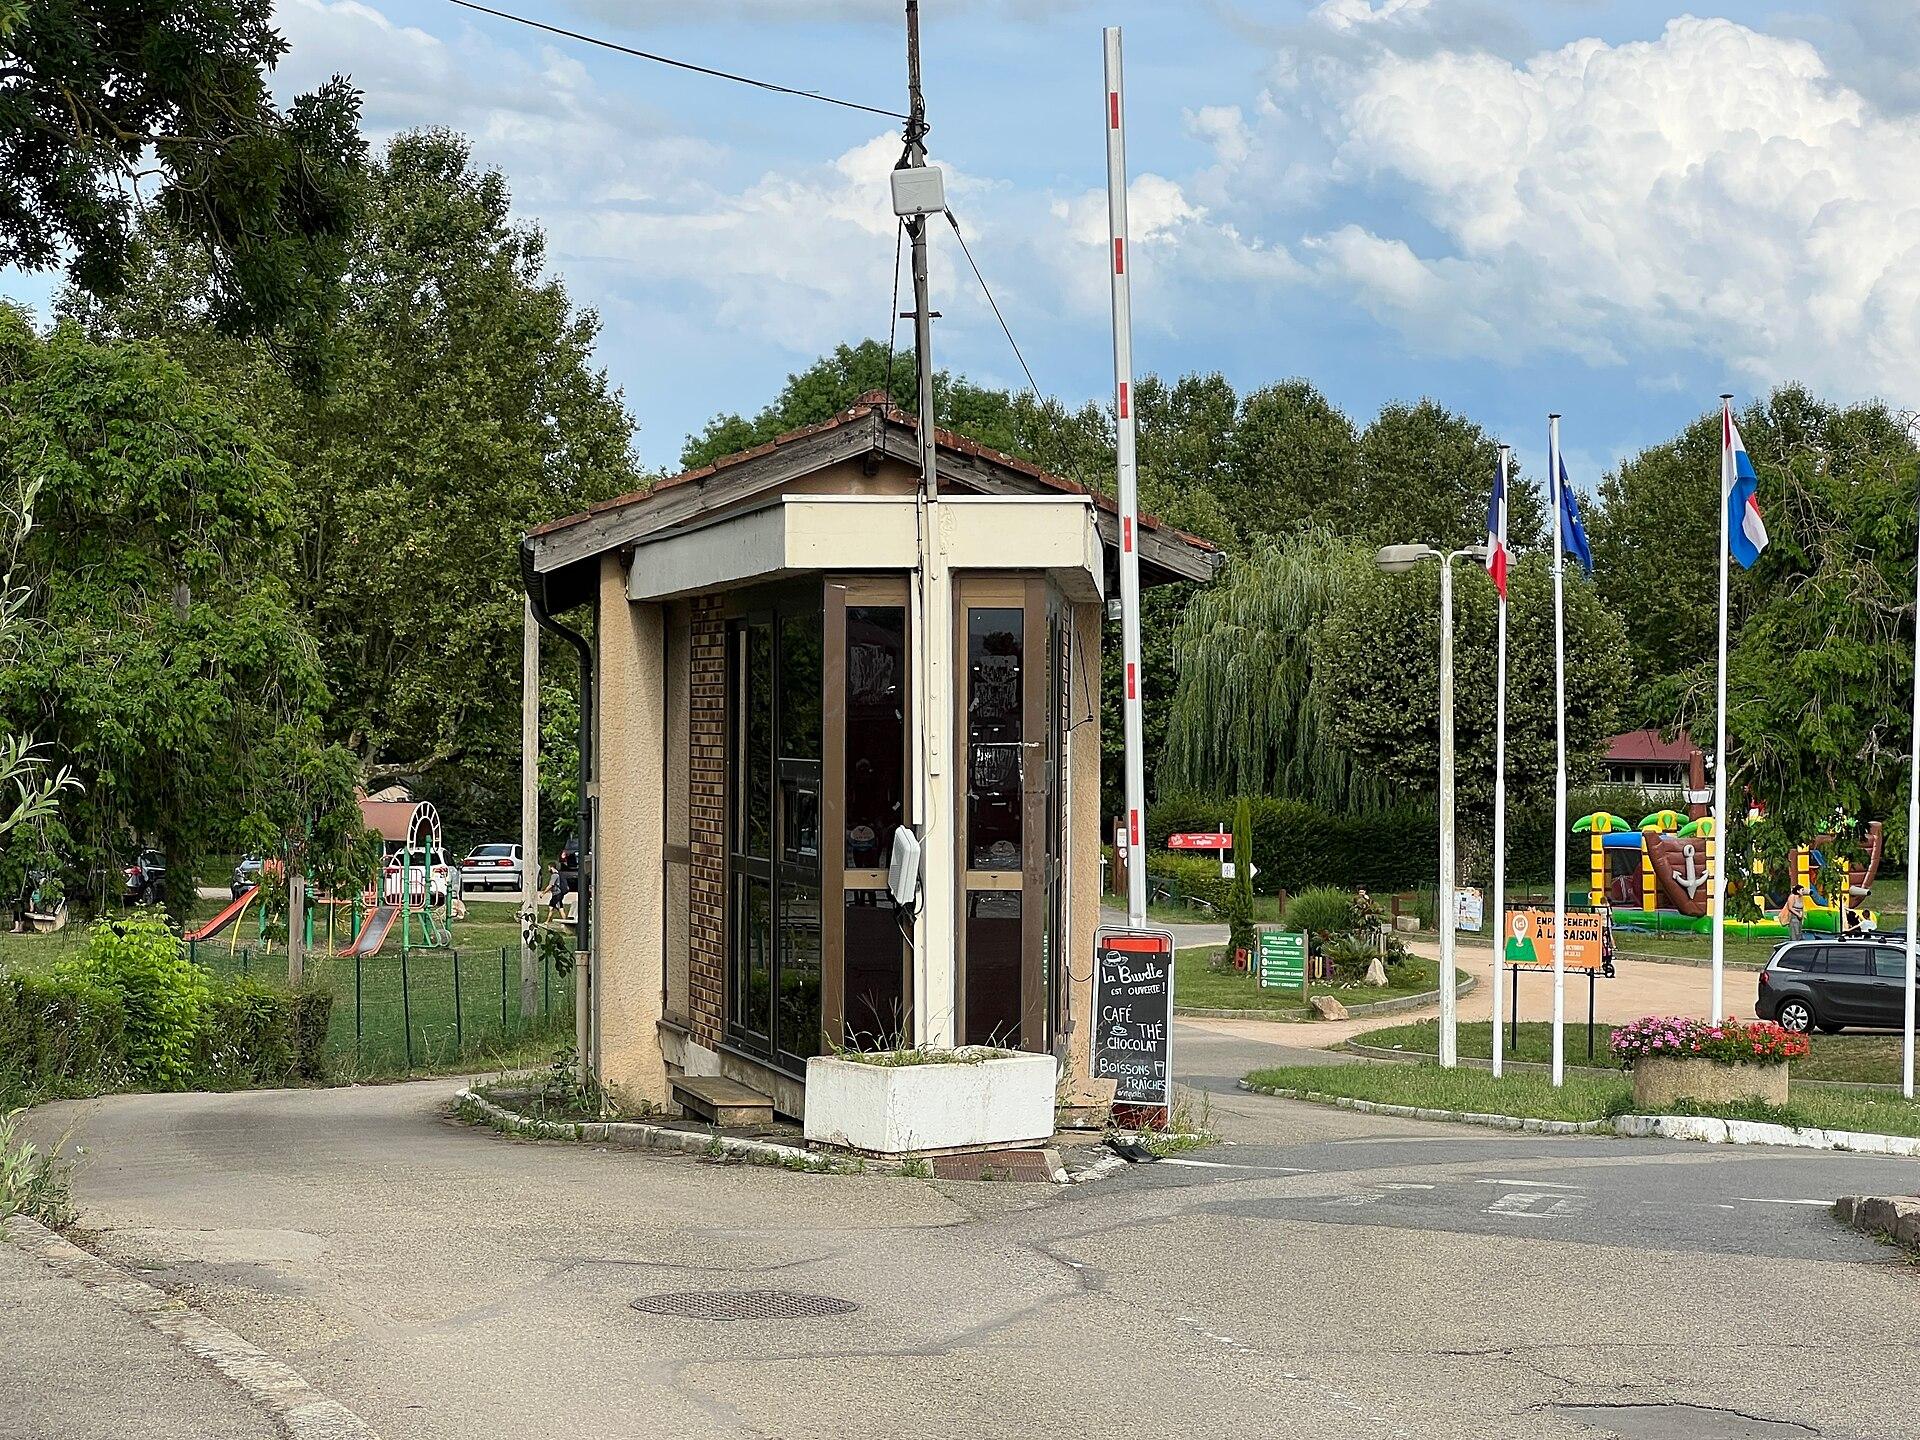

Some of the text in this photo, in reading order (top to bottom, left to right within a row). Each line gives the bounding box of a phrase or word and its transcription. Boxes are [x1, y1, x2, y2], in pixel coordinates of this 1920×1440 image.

[1536, 917, 1598, 927] EMPLCEMENTS
[1564, 930, 1598, 940] SAISON
[1103, 1004, 1133, 1023] CAFÉ
[1136, 1019, 1165, 1040] THÉ
[1107, 1036, 1158, 1052] CHOCOLAT
[1126, 1076, 1166, 1091] FRAÎCHES
